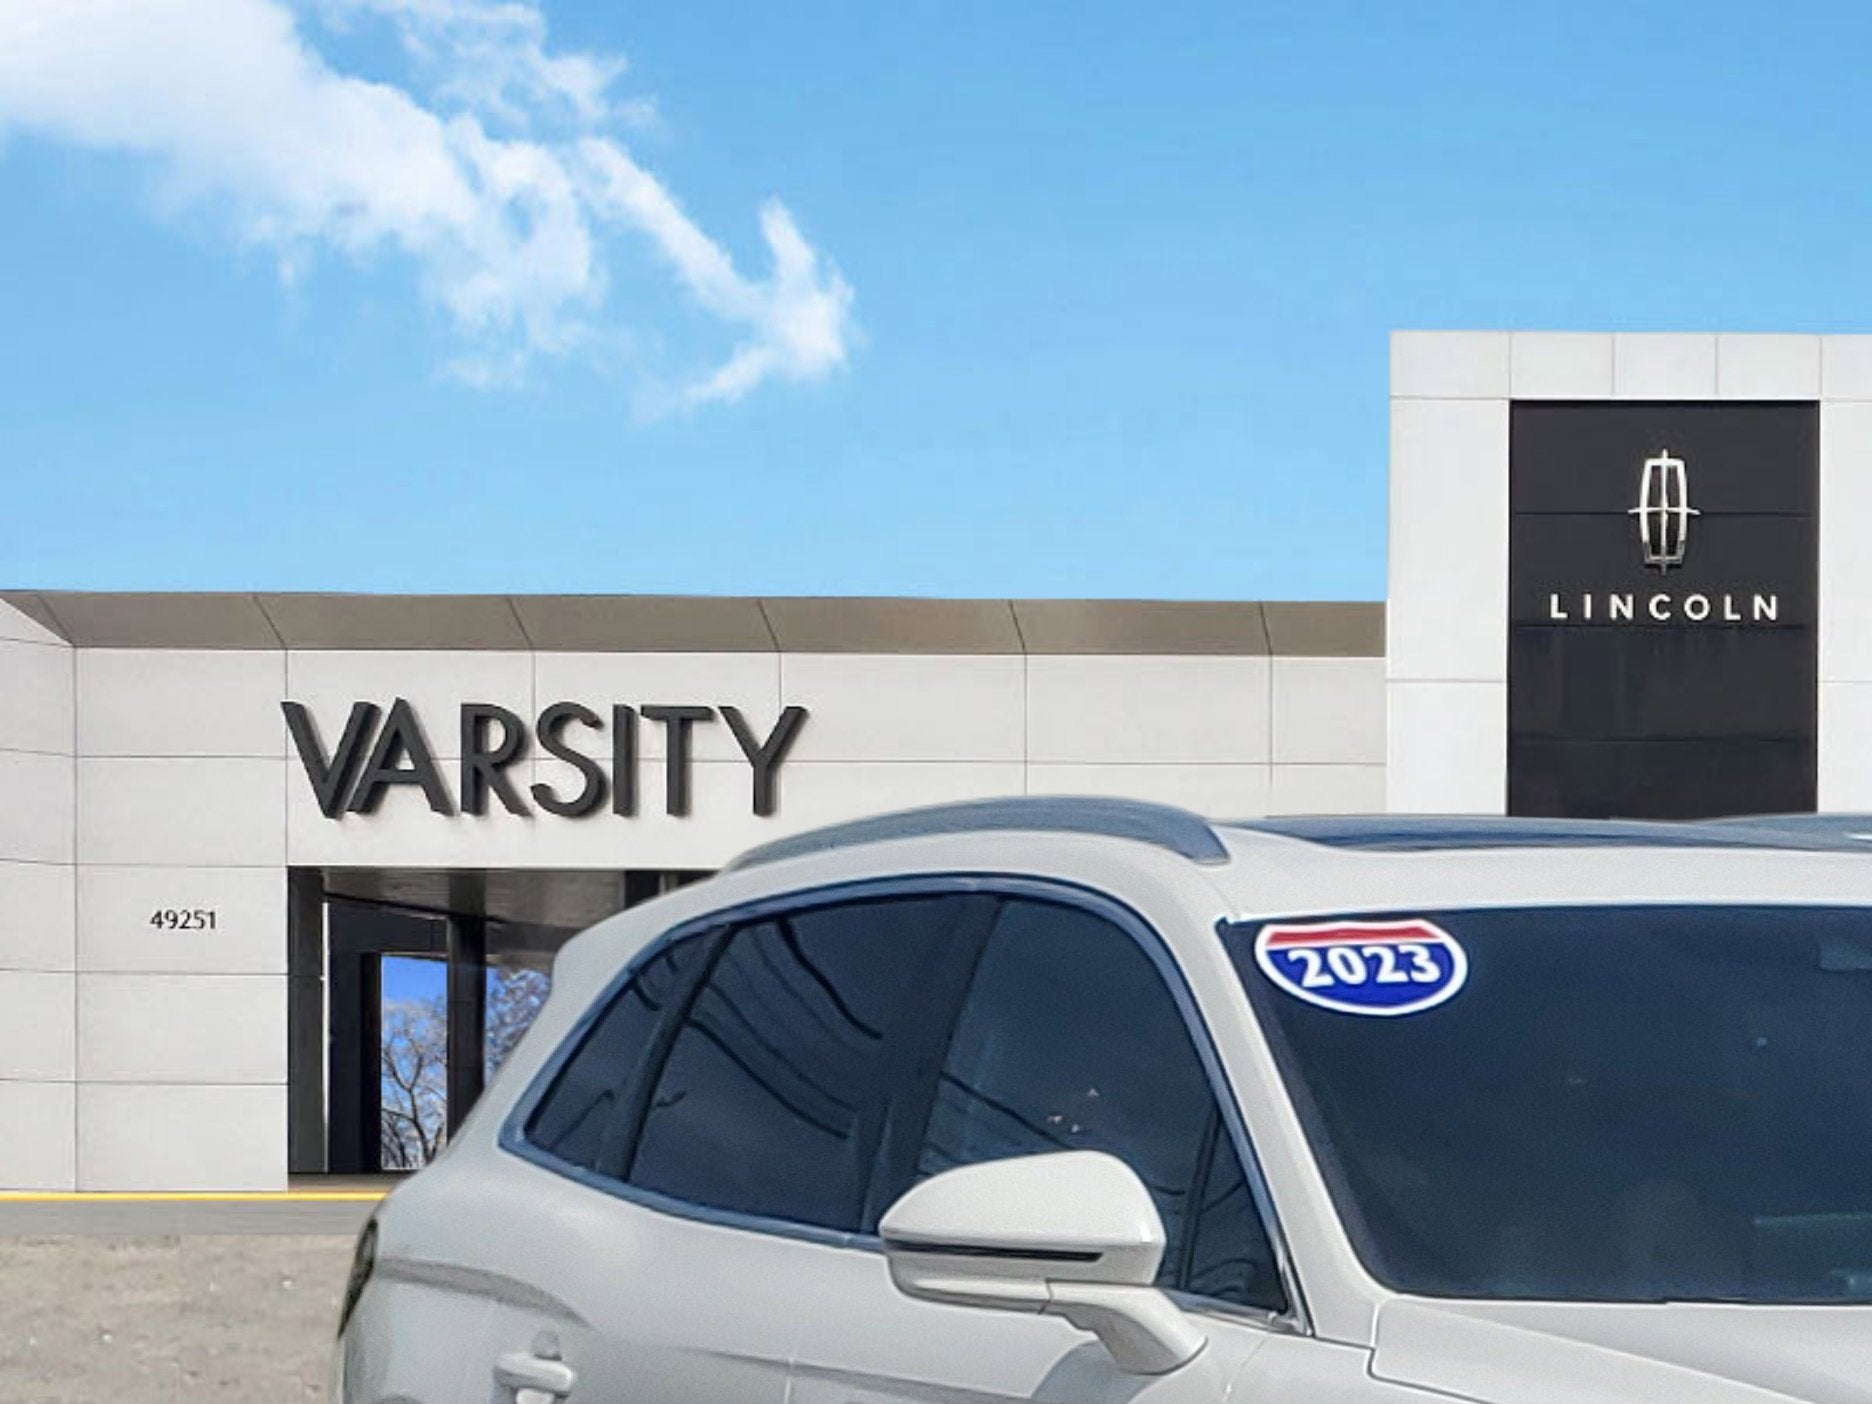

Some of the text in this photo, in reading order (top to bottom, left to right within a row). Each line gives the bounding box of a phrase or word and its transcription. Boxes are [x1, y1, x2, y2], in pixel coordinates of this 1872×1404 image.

[1549, 594, 1778, 621] LINCOLN
[280, 696, 808, 819] VARSITY
[149, 909, 216, 930] 49251
[1287, 944, 1442, 988] 2023
